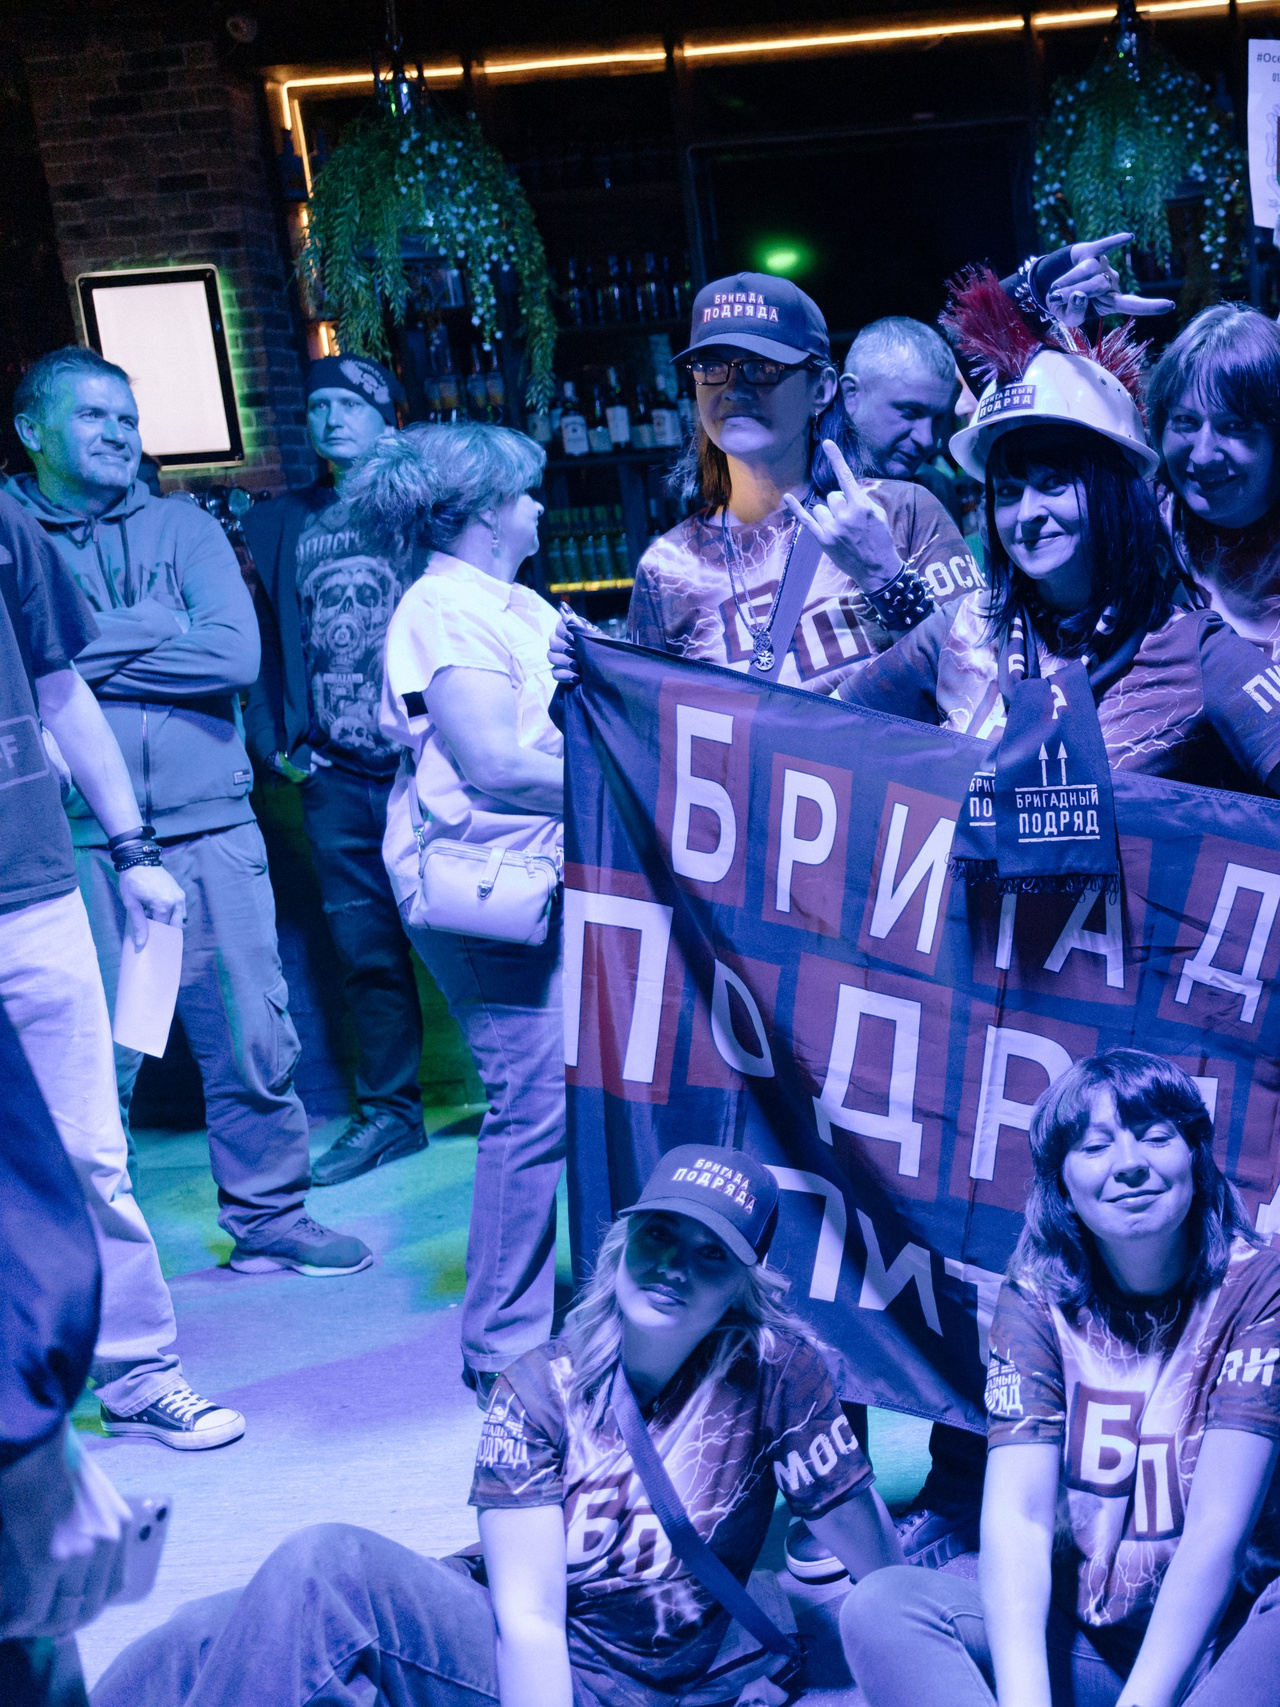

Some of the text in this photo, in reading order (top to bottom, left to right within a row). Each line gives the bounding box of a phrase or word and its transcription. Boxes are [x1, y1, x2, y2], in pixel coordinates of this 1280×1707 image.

[714, 292, 764, 305] БРИГАДА
[703, 303, 779, 323] ПОДРЯДА
[979, 395, 1031, 418] ПОДРЯД
[980, 386, 1034, 408] БРИГАДНЫЙ
[1016, 788, 1100, 809] БРИГАДНЫЙ
[1019, 810, 1100, 836] ПОДРЯД
[694, 1159, 750, 1190] БРИГАДА
[672, 1168, 756, 1214] ПОДРЯДА
[1080, 1400, 1175, 1533] БП
[566, 1486, 673, 1580] БП
